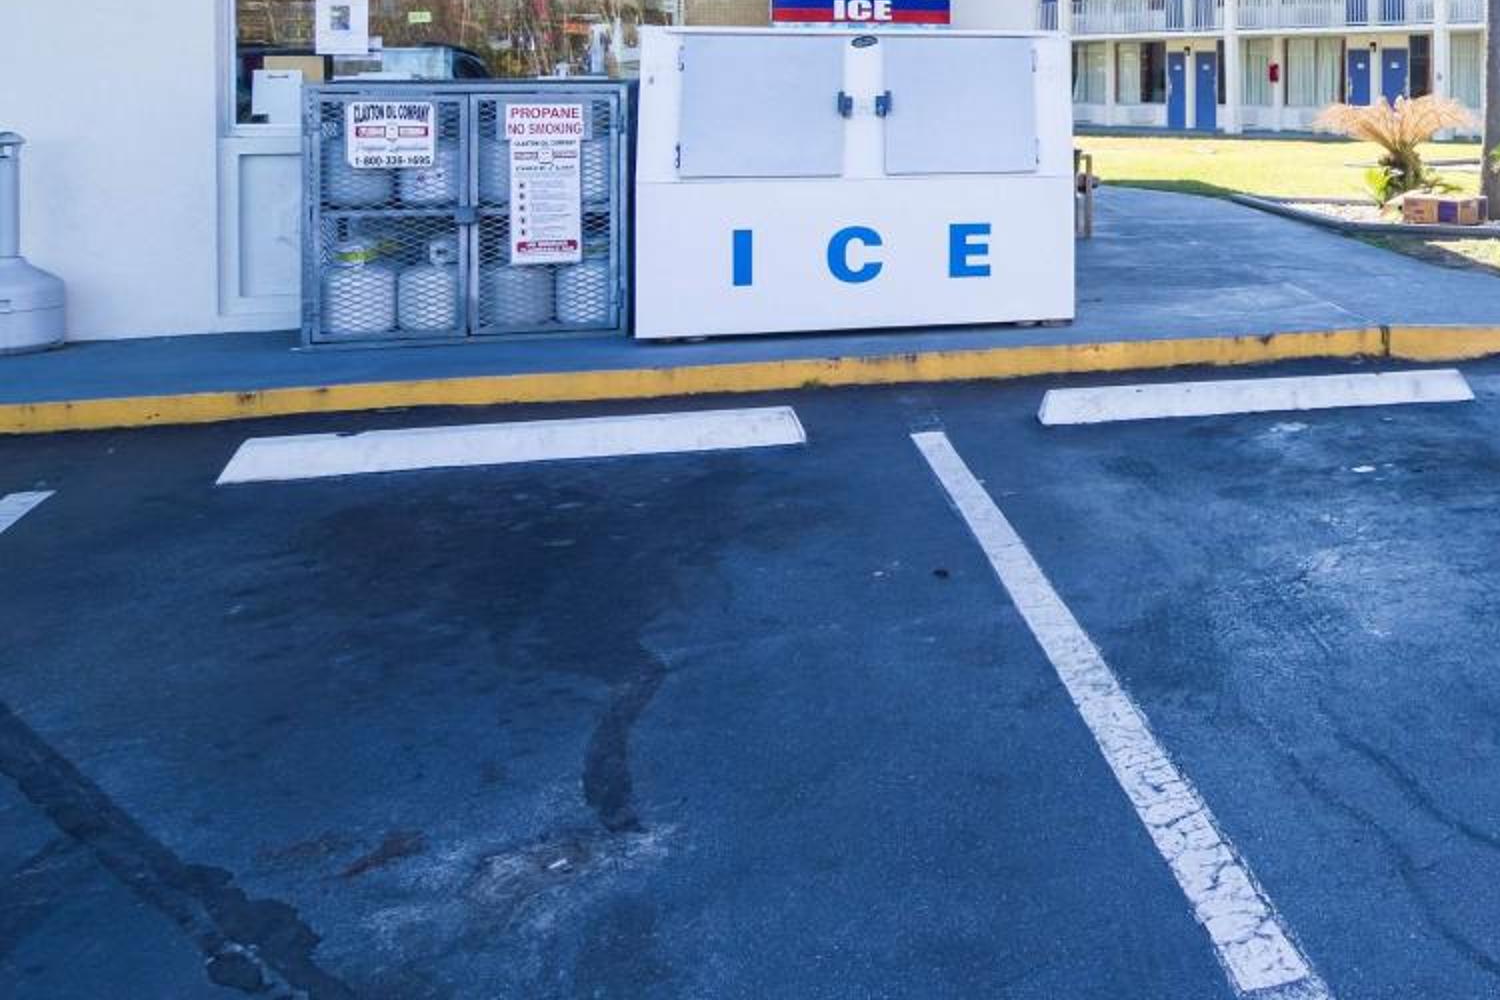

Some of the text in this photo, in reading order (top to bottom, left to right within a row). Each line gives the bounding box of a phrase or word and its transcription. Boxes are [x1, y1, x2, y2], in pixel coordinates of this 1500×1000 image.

[833, 0, 893, 21] ICE
[398, 104, 430, 122] COMPANY
[511, 107, 581, 119] PROPANE
[507, 122, 583, 135] NO SMOKING
[732, 223, 992, 287] ICE
